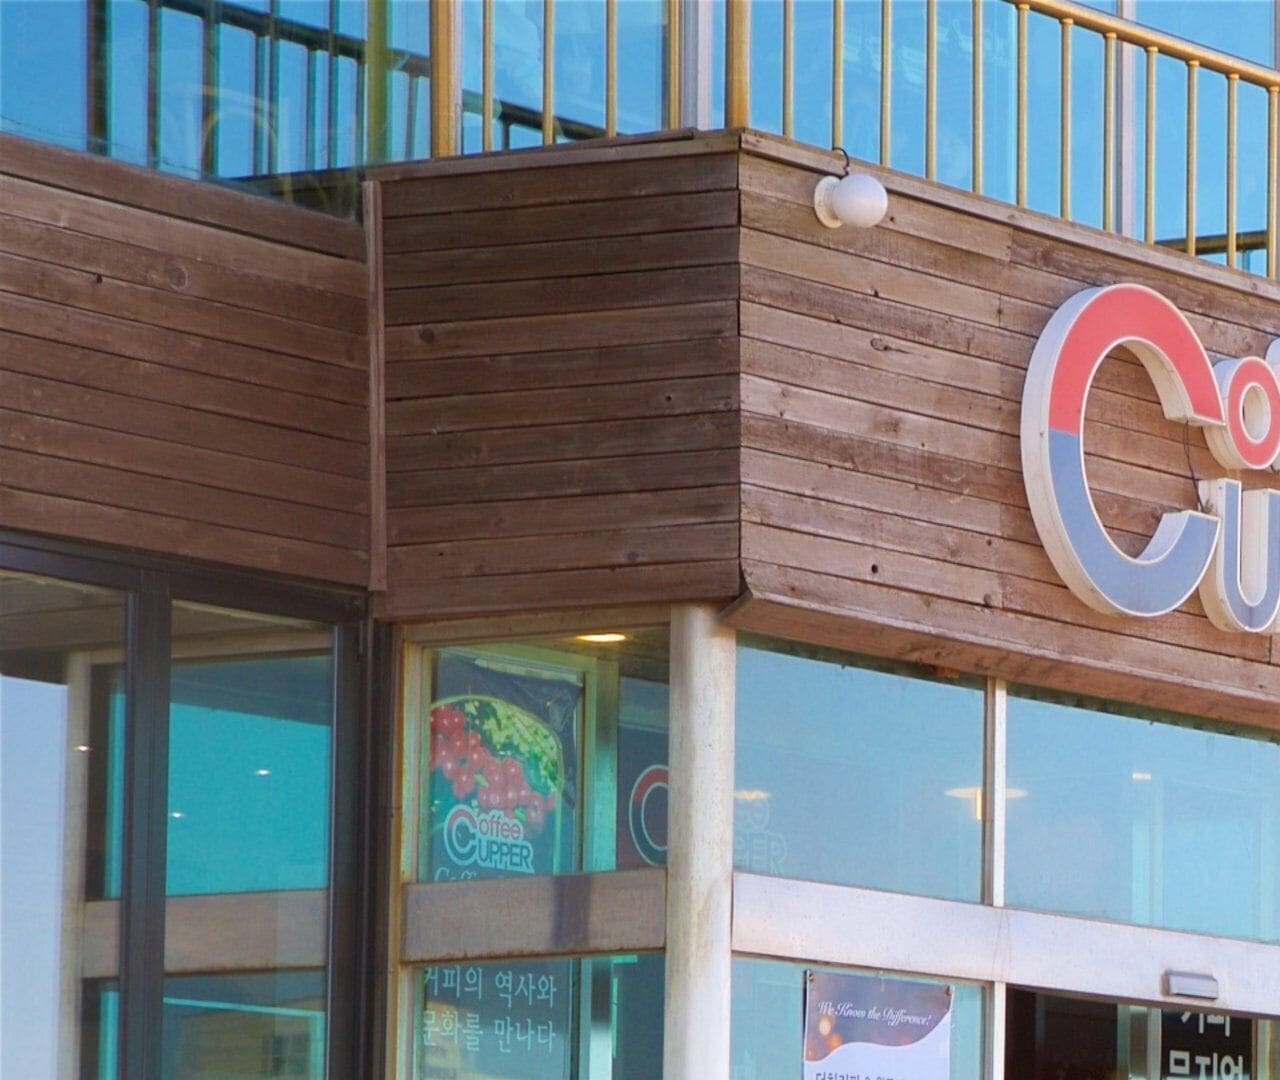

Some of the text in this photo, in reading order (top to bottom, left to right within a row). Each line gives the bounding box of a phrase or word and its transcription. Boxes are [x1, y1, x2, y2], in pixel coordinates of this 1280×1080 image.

[423, 965, 557, 1009] 커피의 역사와
[423, 1009, 556, 1053] 문화를 만나다
[817, 1000, 835, 1016] We
[867, 1005, 881, 1021] the
